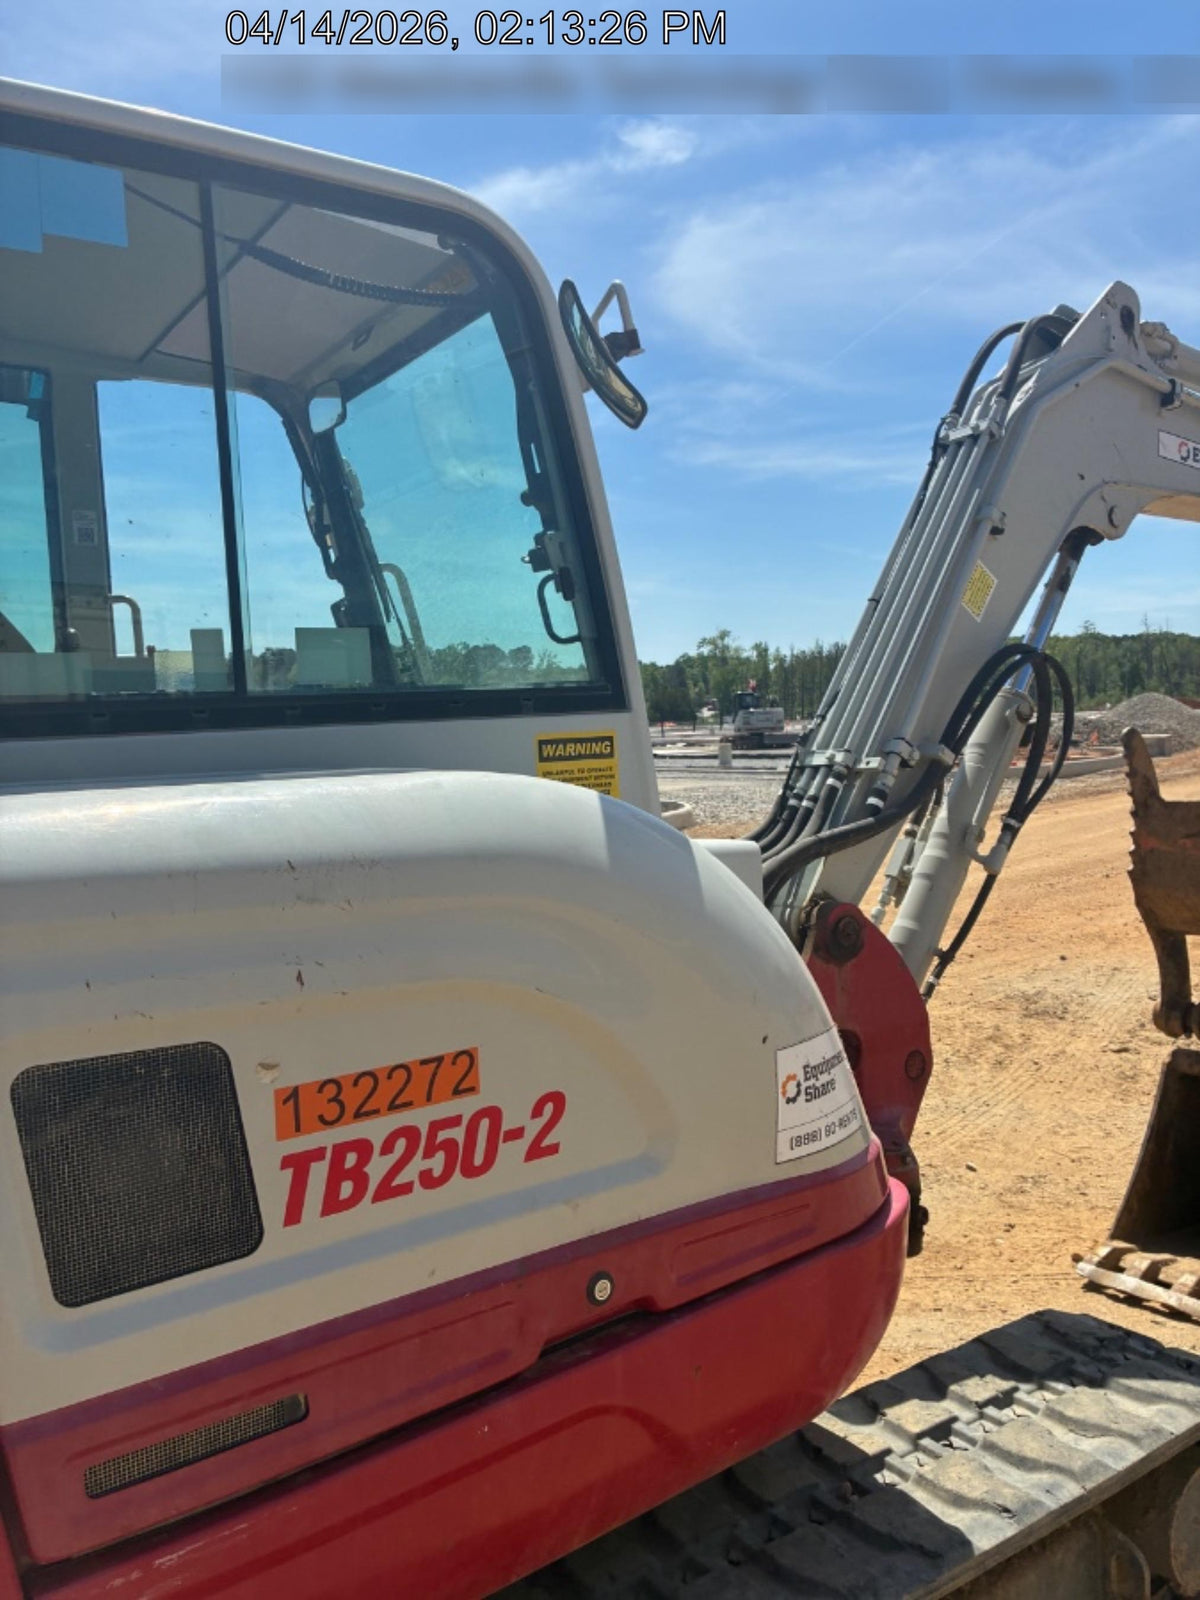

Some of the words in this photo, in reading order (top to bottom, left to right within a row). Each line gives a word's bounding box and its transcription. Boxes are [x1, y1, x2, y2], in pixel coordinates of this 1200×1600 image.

[542, 741, 611, 758] WARNING
[577, 766, 586, 774] TO
[586, 765, 613, 773] OPERATE
[281, 1050, 477, 1133] 132272
[804, 1077, 836, 1103] Share
[790, 1128, 822, 1150] (888)
[279, 1090, 566, 1229] TB250-2
